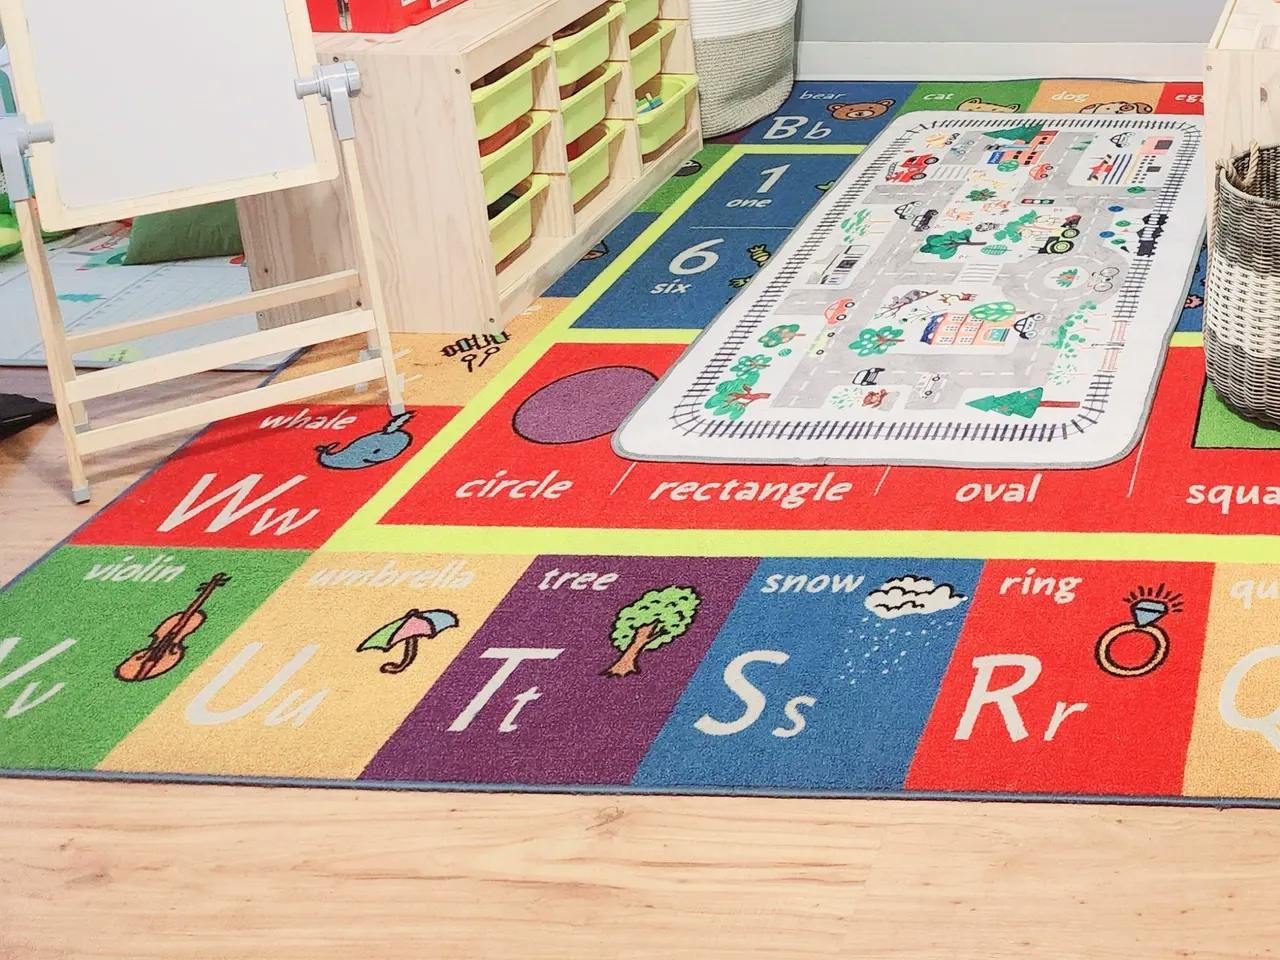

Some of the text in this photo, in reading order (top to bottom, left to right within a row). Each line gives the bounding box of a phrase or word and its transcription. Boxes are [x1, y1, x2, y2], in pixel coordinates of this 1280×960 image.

[799, 90, 846, 100] bear
[923, 93, 954, 101] cat
[1052, 91, 1089, 103] dog
[763, 115, 832, 140] Bb
[757, 165, 790, 192] 1
[726, 198, 772, 209] one
[669, 239, 723, 274] 6
[651, 279, 691, 293] six
[259, 407, 357, 430] whale
[456, 470, 572, 498] circle
[649, 473, 852, 509] rectangle
[956, 474, 1042, 502] oval
[84, 555, 185, 582] violin
[309, 560, 475, 590] umbrella
[538, 568, 619, 590] tree
[761, 574, 865, 593] snow
[1000, 568, 1082, 604] ring
